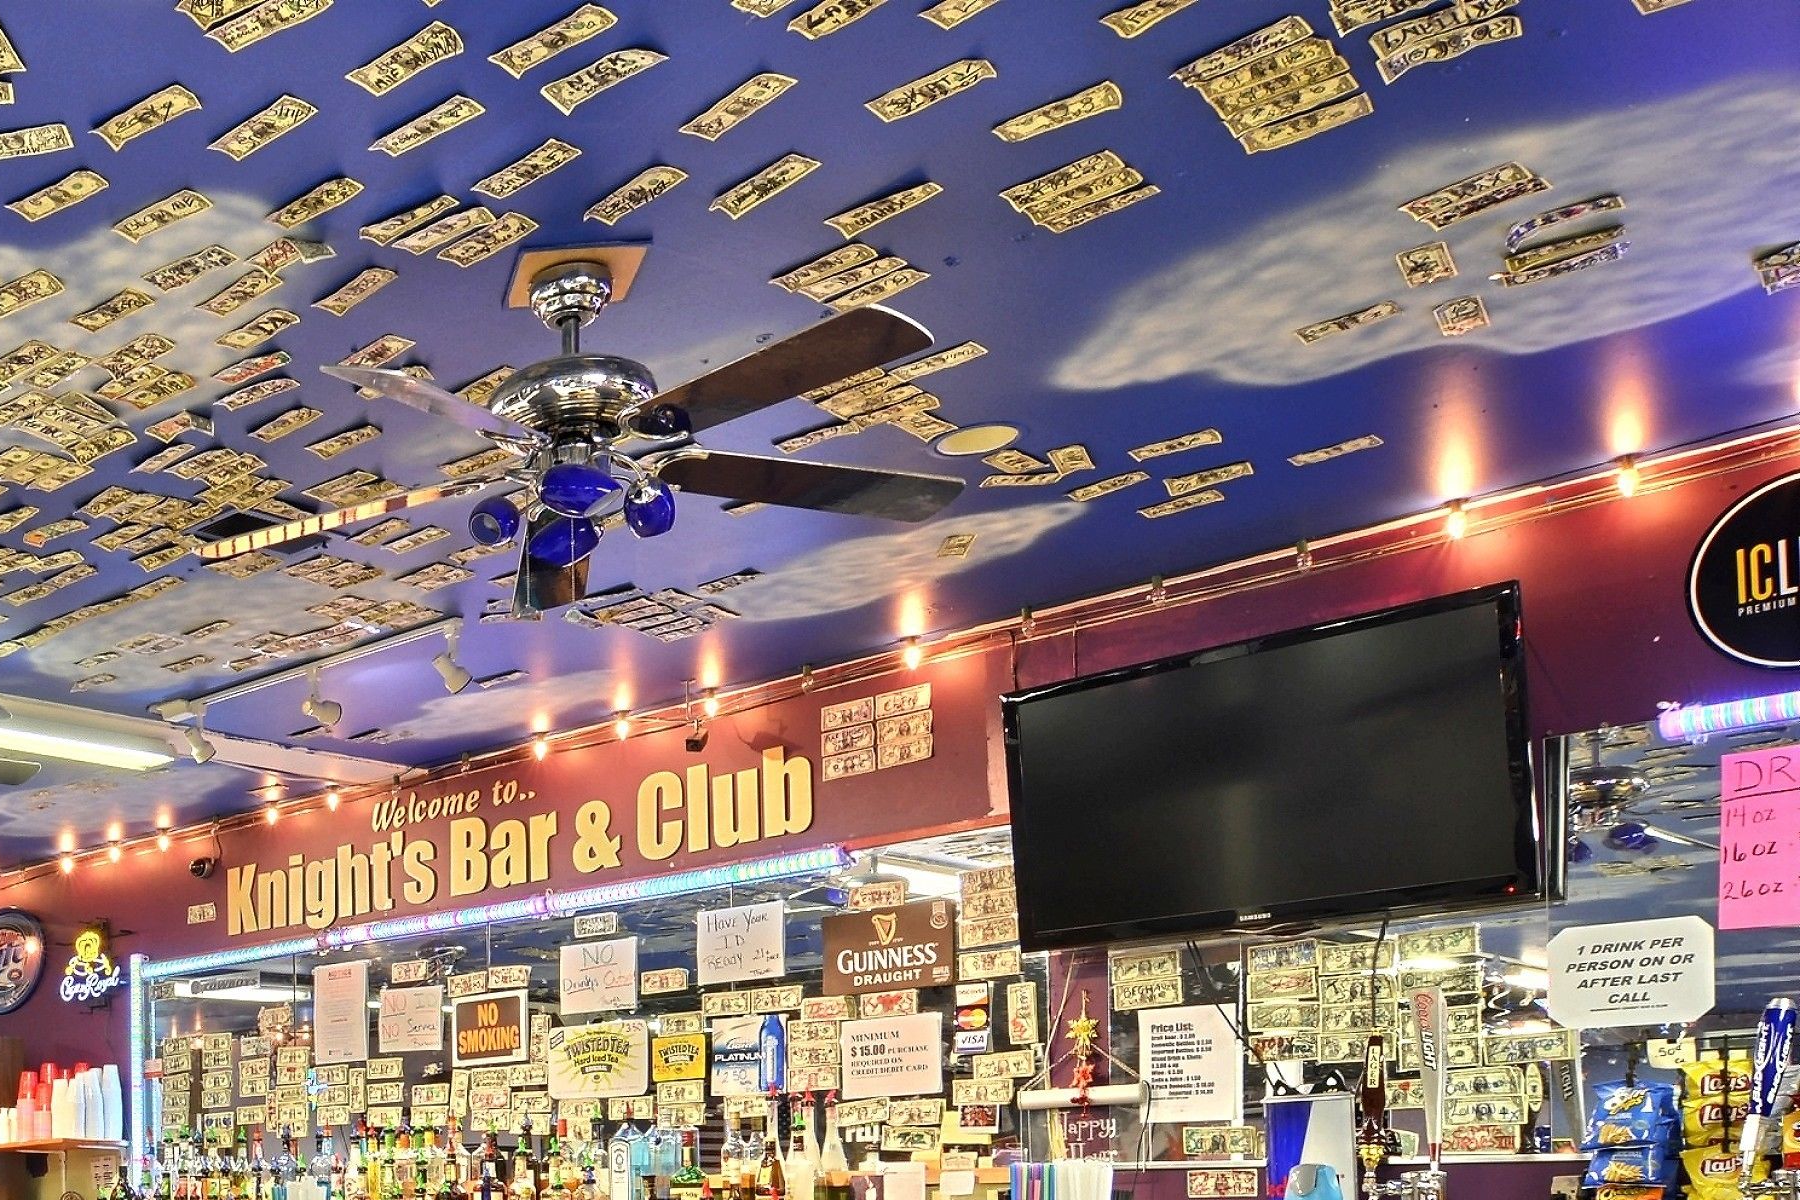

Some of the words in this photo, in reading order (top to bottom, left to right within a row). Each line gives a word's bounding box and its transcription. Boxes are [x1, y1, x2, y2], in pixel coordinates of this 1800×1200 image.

[1736, 537, 1800, 605] I.C.L
[1738, 596, 1797, 617] PREMIUM
[1734, 756, 1797, 793] DR
[371, 788, 480, 833] Welcome
[226, 830, 438, 937] Knight's
[450, 810, 558, 898] Bar
[572, 799, 623, 874] &
[636, 744, 814, 861] Club
[581, 944, 614, 968] NO
[1577, 945, 1586, 956] 1
[1590, 939, 1646, 955] DRINK
[1649, 937, 1685, 949] PER
[837, 942, 937, 974] GUINNESS
[1565, 959, 1635, 974] PERSON
[1639, 956, 1665, 968] ON
[1669, 953, 1695, 965] OR
[853, 968, 922, 987] DRAUGHT
[1576, 976, 1633, 990] AFTER
[1637, 972, 1684, 985] LAST
[383, 993, 407, 1015] NO
[1608, 992, 1651, 1004] CALL
[477, 1003, 499, 1027] NO
[381, 1023, 400, 1039] NO
[851, 1031, 900, 1042] MINIMUM
[1151, 1023, 1174, 1033] Price
[458, 1025, 520, 1054] SMOKING
[564, 1037, 609, 1060] TWISTED
[610, 1036, 630, 1057] TEA
[962, 1035, 985, 1045] VISA
[658, 1044, 688, 1058] TWISTED
[688, 1044, 699, 1055] TEA
[715, 1052, 767, 1062] PLATINUM
[860, 1044, 885, 1056] 15.00
[888, 1045, 929, 1054] PURCHASE
[1420, 1030, 1438, 1071] LIGHT
[574, 1056, 591, 1067] Hard
[592, 1054, 607, 1063] Iced
[608, 1054, 619, 1063] Tea
[851, 1059, 890, 1067] REQUIRED
[905, 1064, 929, 1072] CARD
